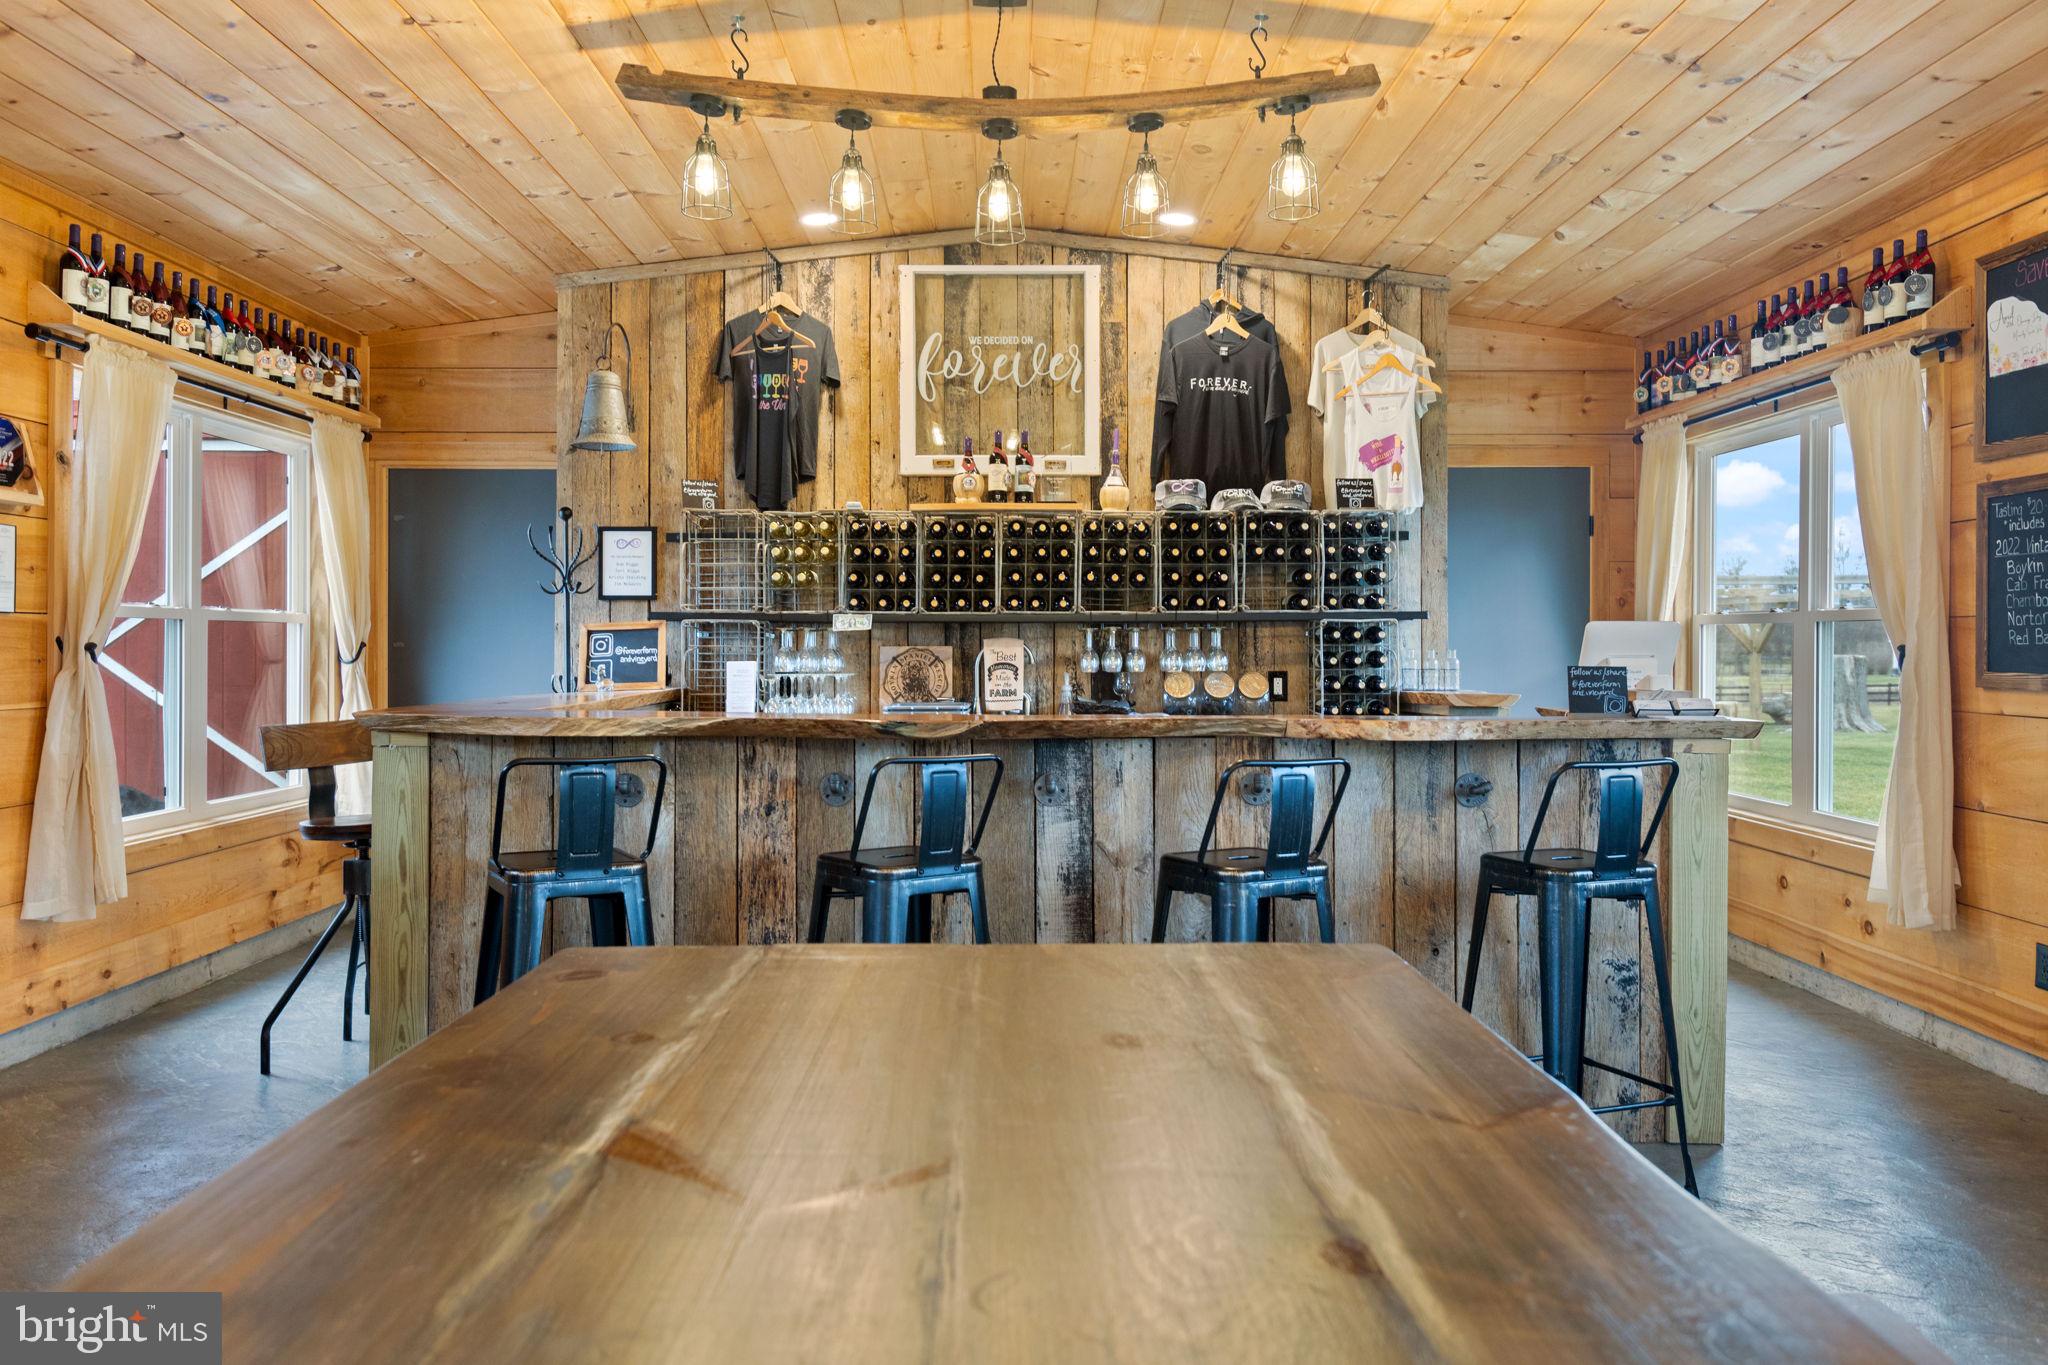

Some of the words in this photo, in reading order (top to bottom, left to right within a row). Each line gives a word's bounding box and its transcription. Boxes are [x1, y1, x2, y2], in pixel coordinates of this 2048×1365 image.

[968, 335, 983, 345] WE
[984, 335, 1019, 345] DECIDED
[1021, 335, 1034, 345] ON
[917, 332, 1082, 402] forever
[1190, 376, 1248, 390] FOREVER
[1991, 502, 2023, 519] Tasting
[2027, 496, 2044, 514] $20
[1995, 537, 2020, 556] 2022
[2006, 557, 2044, 581] Boykin
[2006, 577, 2028, 591] Cab
[2009, 627, 2029, 645] Red
[898, 652, 932, 663] SPANIEL
[996, 651, 1017, 662] Best
[933, 662, 944, 695] RESCUE
[1570, 666, 1592, 677] follow
[988, 688, 1018, 698] FARM
